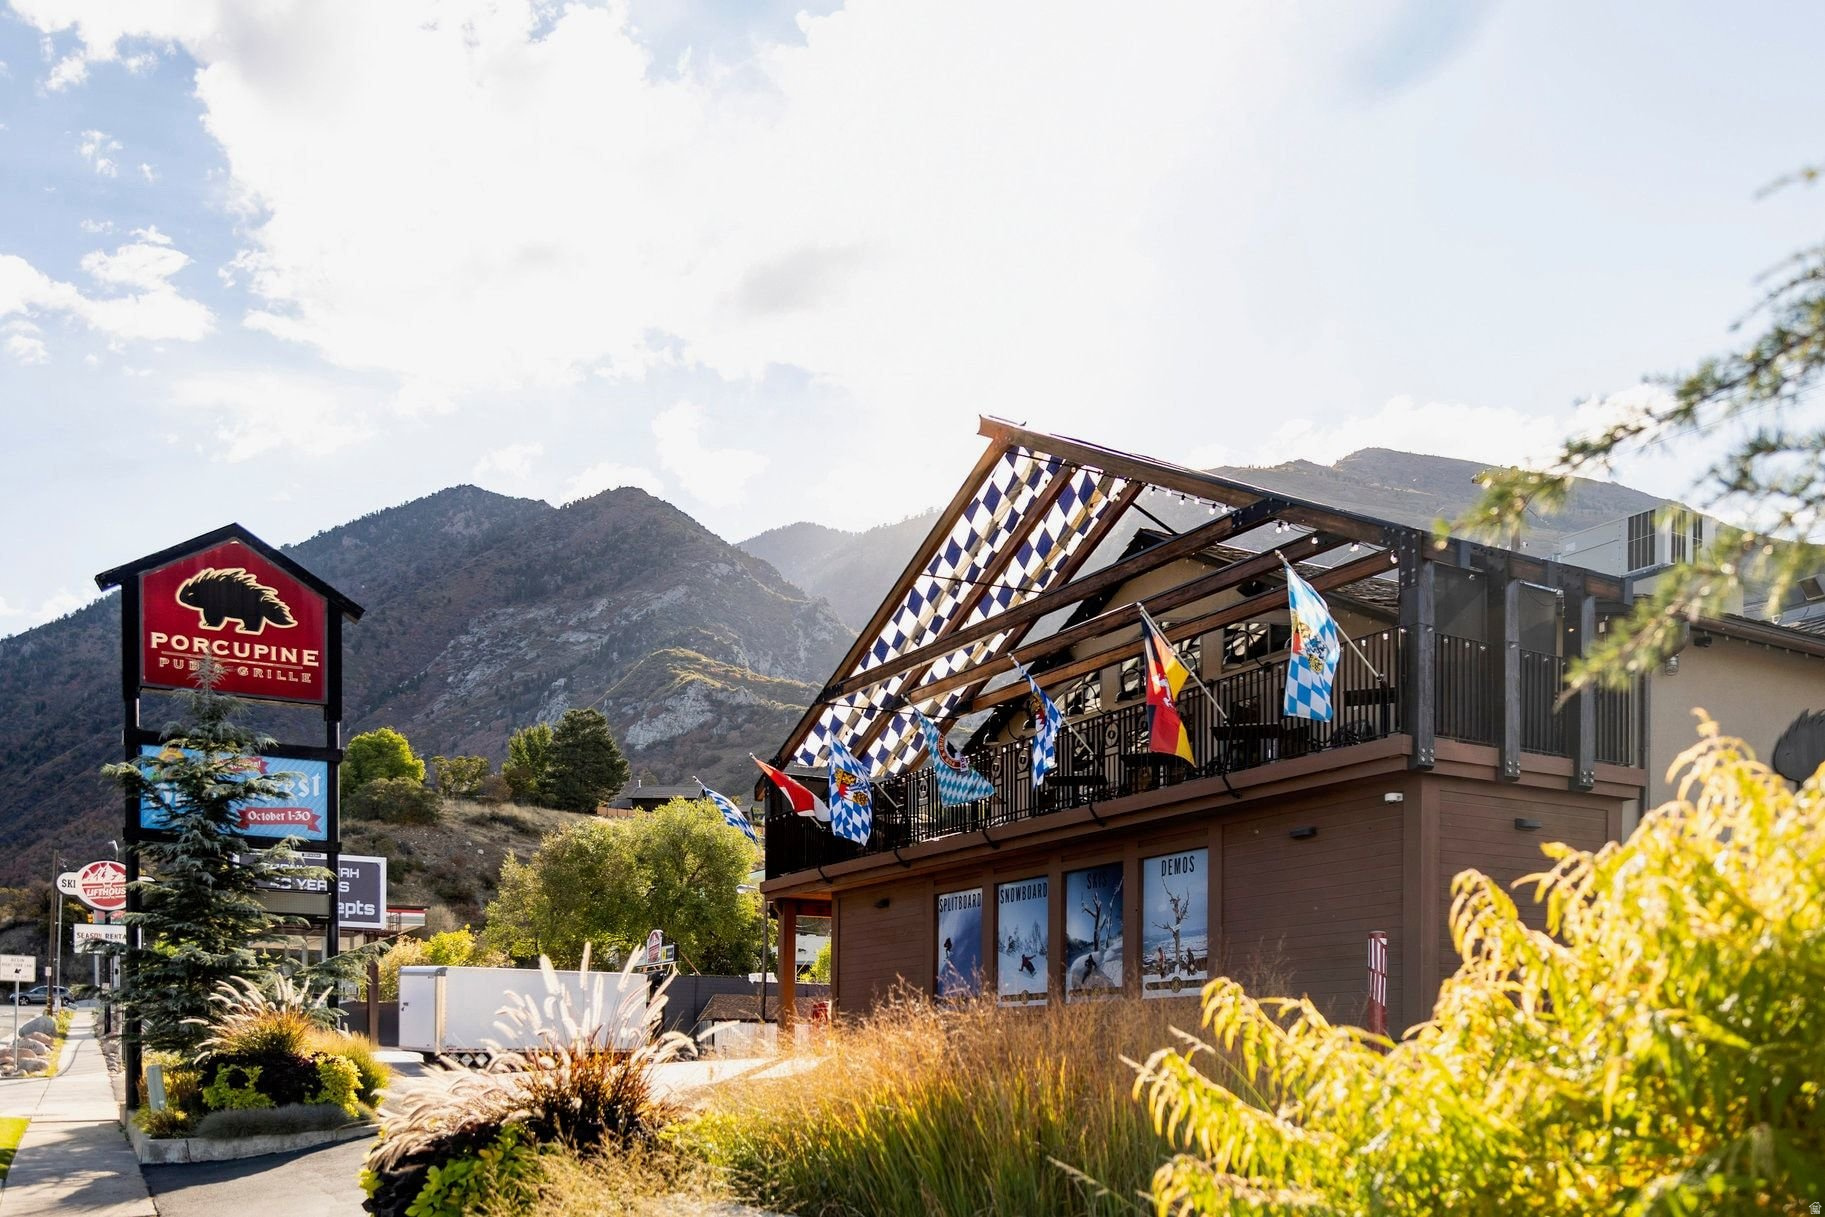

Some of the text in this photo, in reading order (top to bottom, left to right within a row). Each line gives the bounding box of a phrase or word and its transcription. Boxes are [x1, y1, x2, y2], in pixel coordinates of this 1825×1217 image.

[150, 631, 320, 668] PORCUPINE
[159, 656, 201, 672] PUB
[237, 665, 313, 684] GRILLE
[247, 809, 311, 822] October 1-30
[1161, 855, 1195, 877] DEMOS
[61, 878, 76, 889] SKI
[86, 887, 127, 897] LIFTHOUS
[1000, 881, 1048, 905] SNOWBOARD
[939, 892, 982, 913] SPLITBOARD
